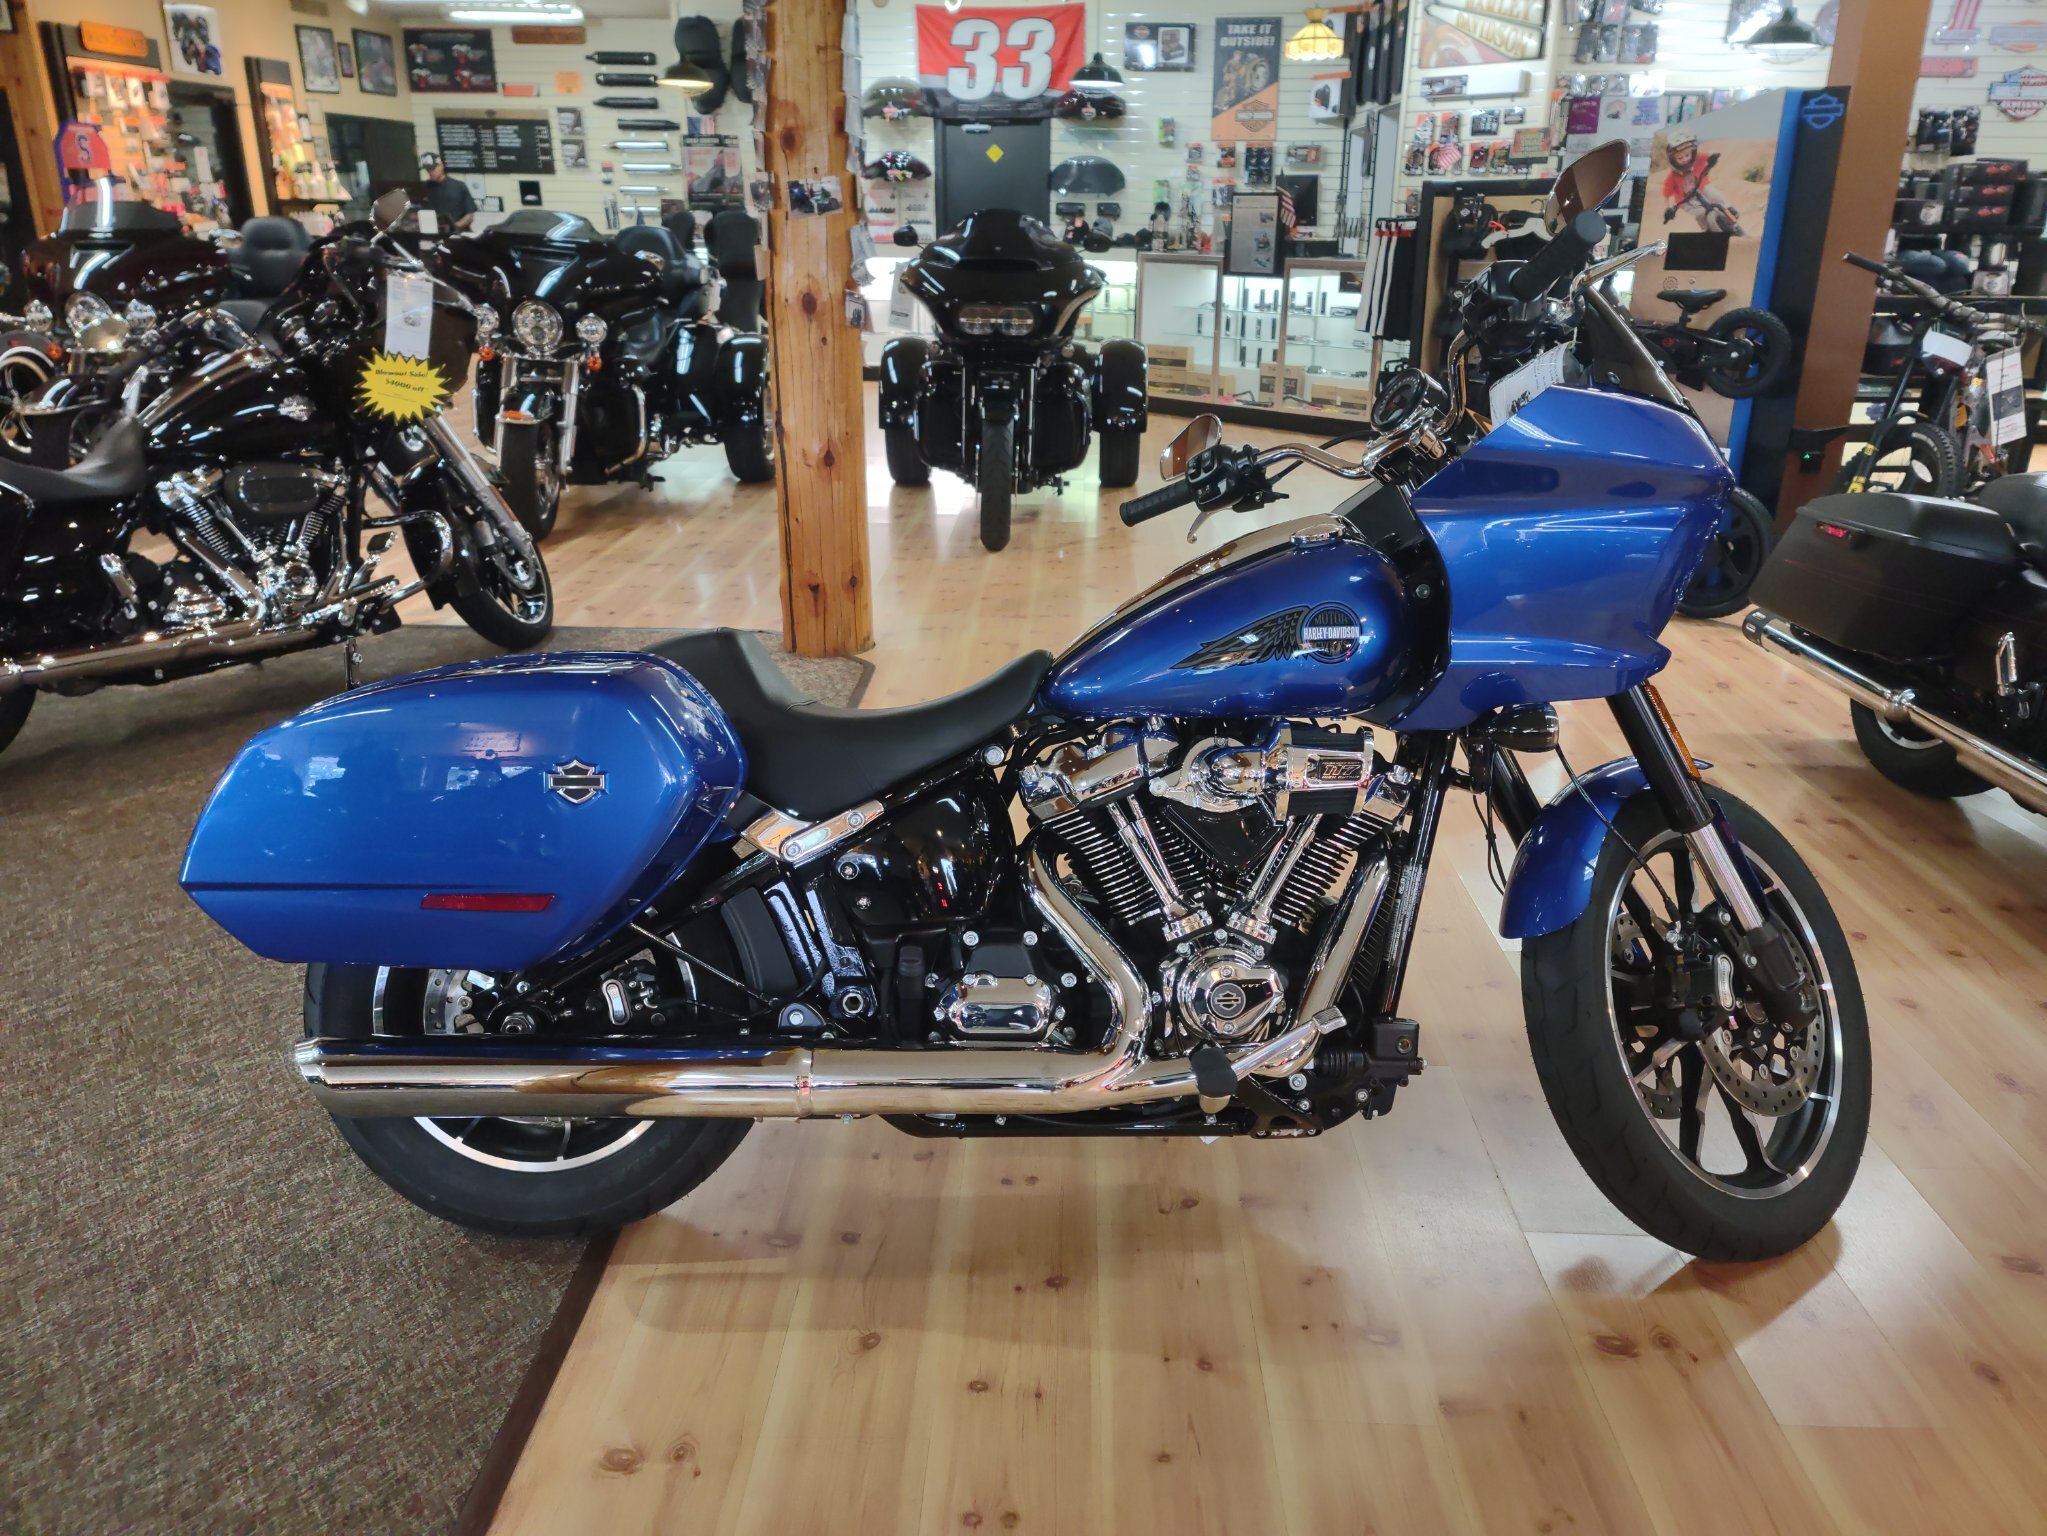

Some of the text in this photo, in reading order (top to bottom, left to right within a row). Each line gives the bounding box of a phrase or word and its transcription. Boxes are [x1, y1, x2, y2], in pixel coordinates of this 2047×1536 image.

[1227, 24, 1273, 35] TAKE IT
[1220, 36, 1276, 47] OUTSIDE!
[947, 17, 1056, 100] 33
[1314, 610, 1349, 625] MOTOR
[1303, 626, 1360, 640] HARLEY-DAVIDSON
[1322, 764, 1361, 776] 117
